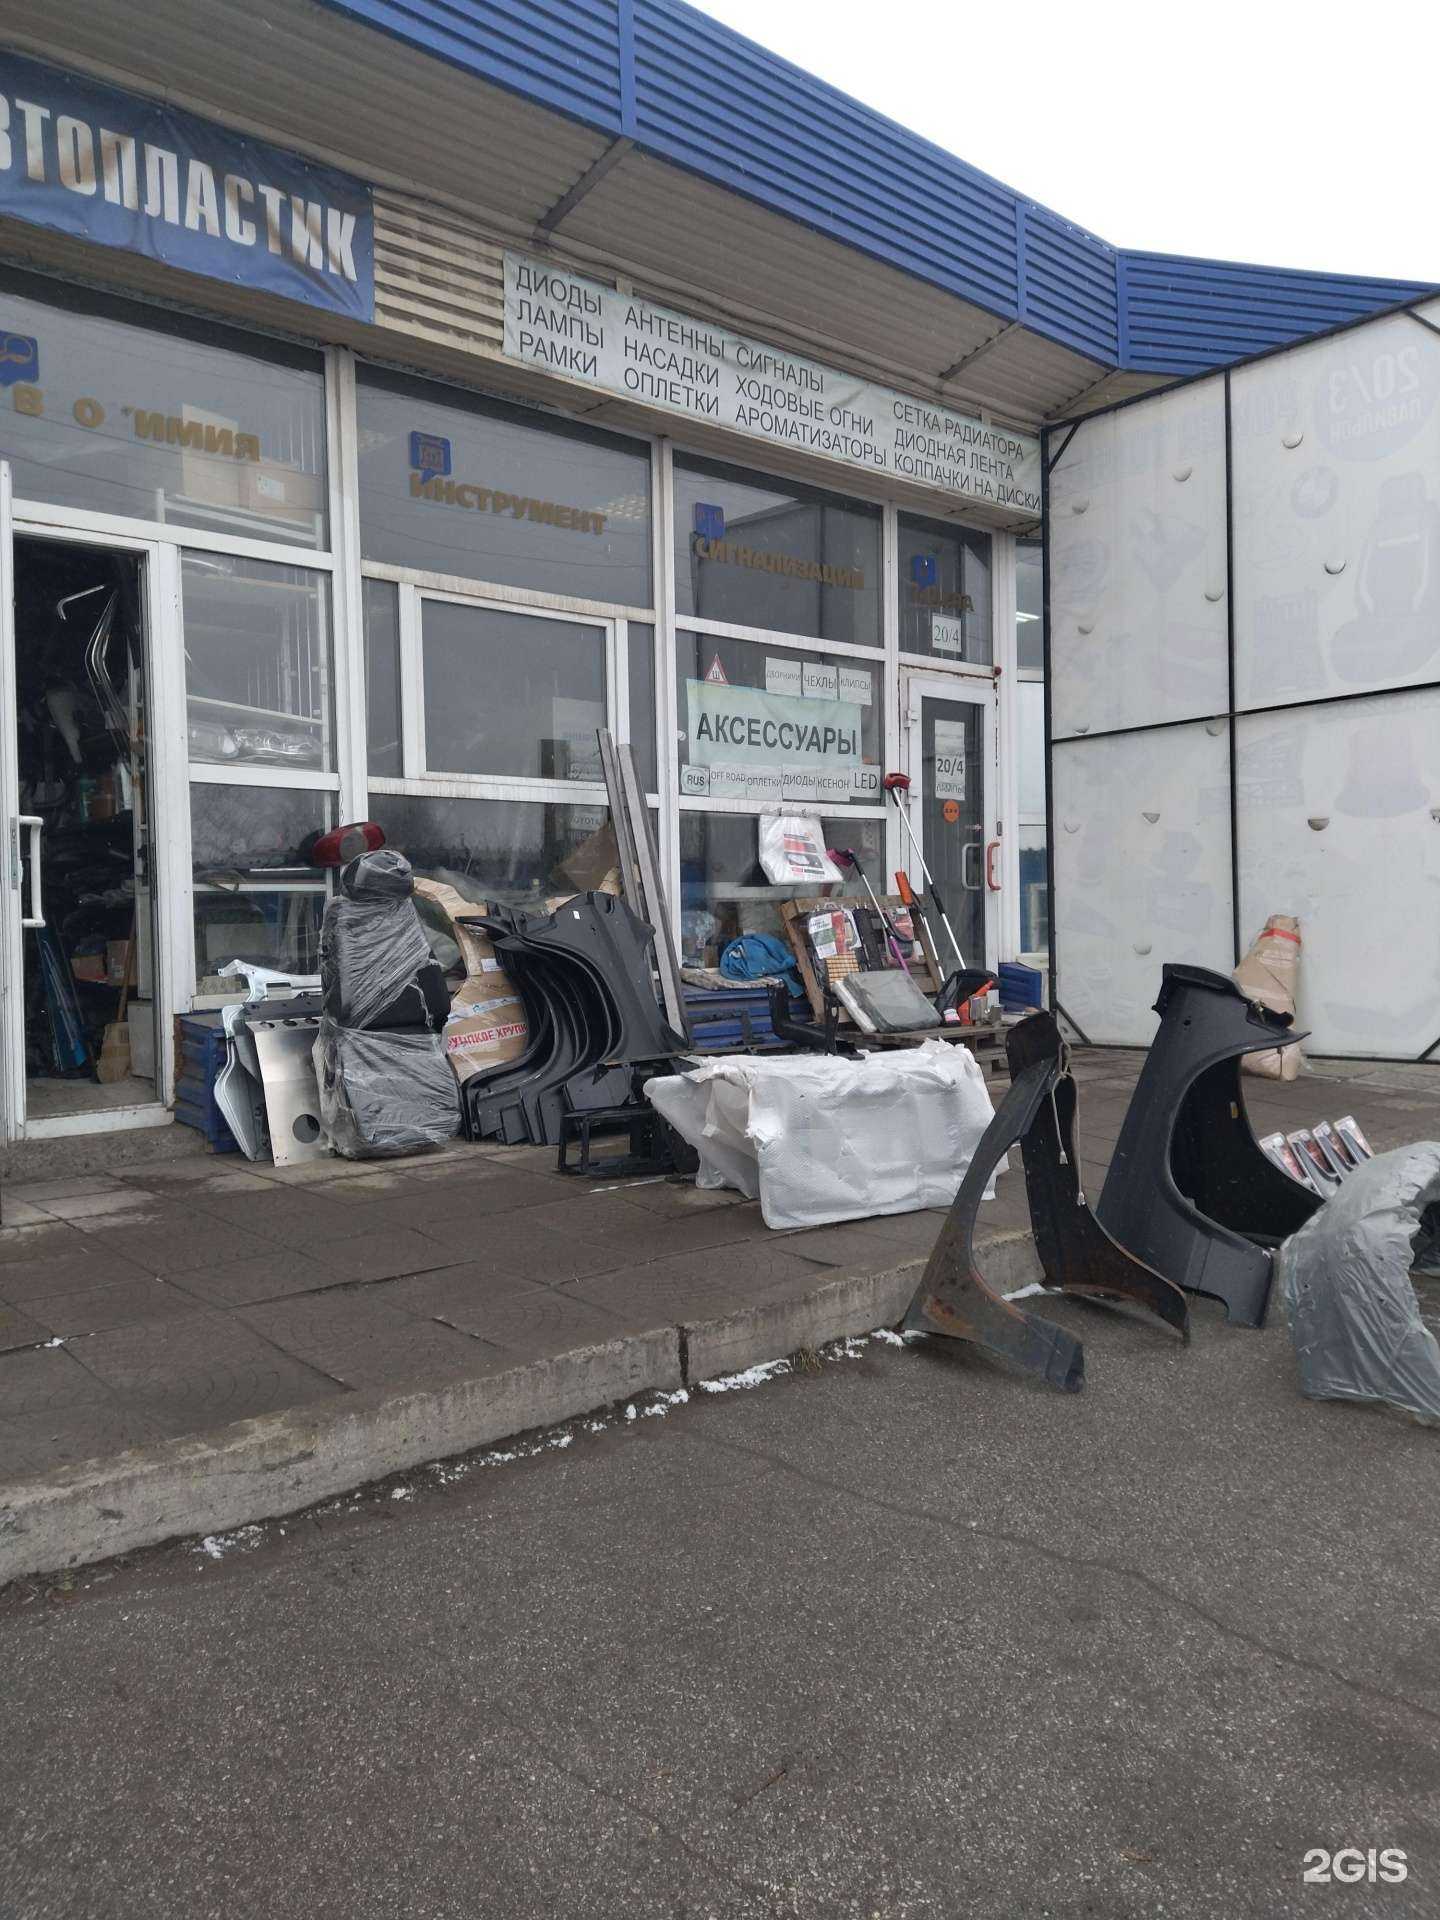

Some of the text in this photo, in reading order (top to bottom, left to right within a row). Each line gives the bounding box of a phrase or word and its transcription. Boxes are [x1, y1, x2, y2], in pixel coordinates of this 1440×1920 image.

[516, 265, 1024, 460] ДИОДЫ АНТЕННЫ СИГНАЛЫ СЕТКА РАДИАТОРА
[517, 300, 1014, 481] ЛАМПЫ НАСАДКИ ХОДОВЫЕ ОГНИ ДИОДНАЯ ЛЕНТА
[520, 331, 1041, 512] РАМКИ ОПЛЕТКИ АРОМАТИЗАТОРЫ КОЛПАЧКИ НА ДИСКИ
[934, 625, 959, 645] 20/4
[804, 674, 837, 690] ЧЕХЛЫ
[840, 676, 871, 690] КЛИПСЫ
[696, 712, 857, 755] АКСЕССУАРЫ
[937, 758, 964, 777] 20/4
[687, 774, 705, 787] RUS
[711, 771, 745, 782] OFF ROAD
[747, 777, 781, 787] ОПЛЕТКИ
[783, 774, 816, 786] ДИОДЫ
[818, 776, 849, 789] КСЕНОН
[854, 772, 878, 790] LED
